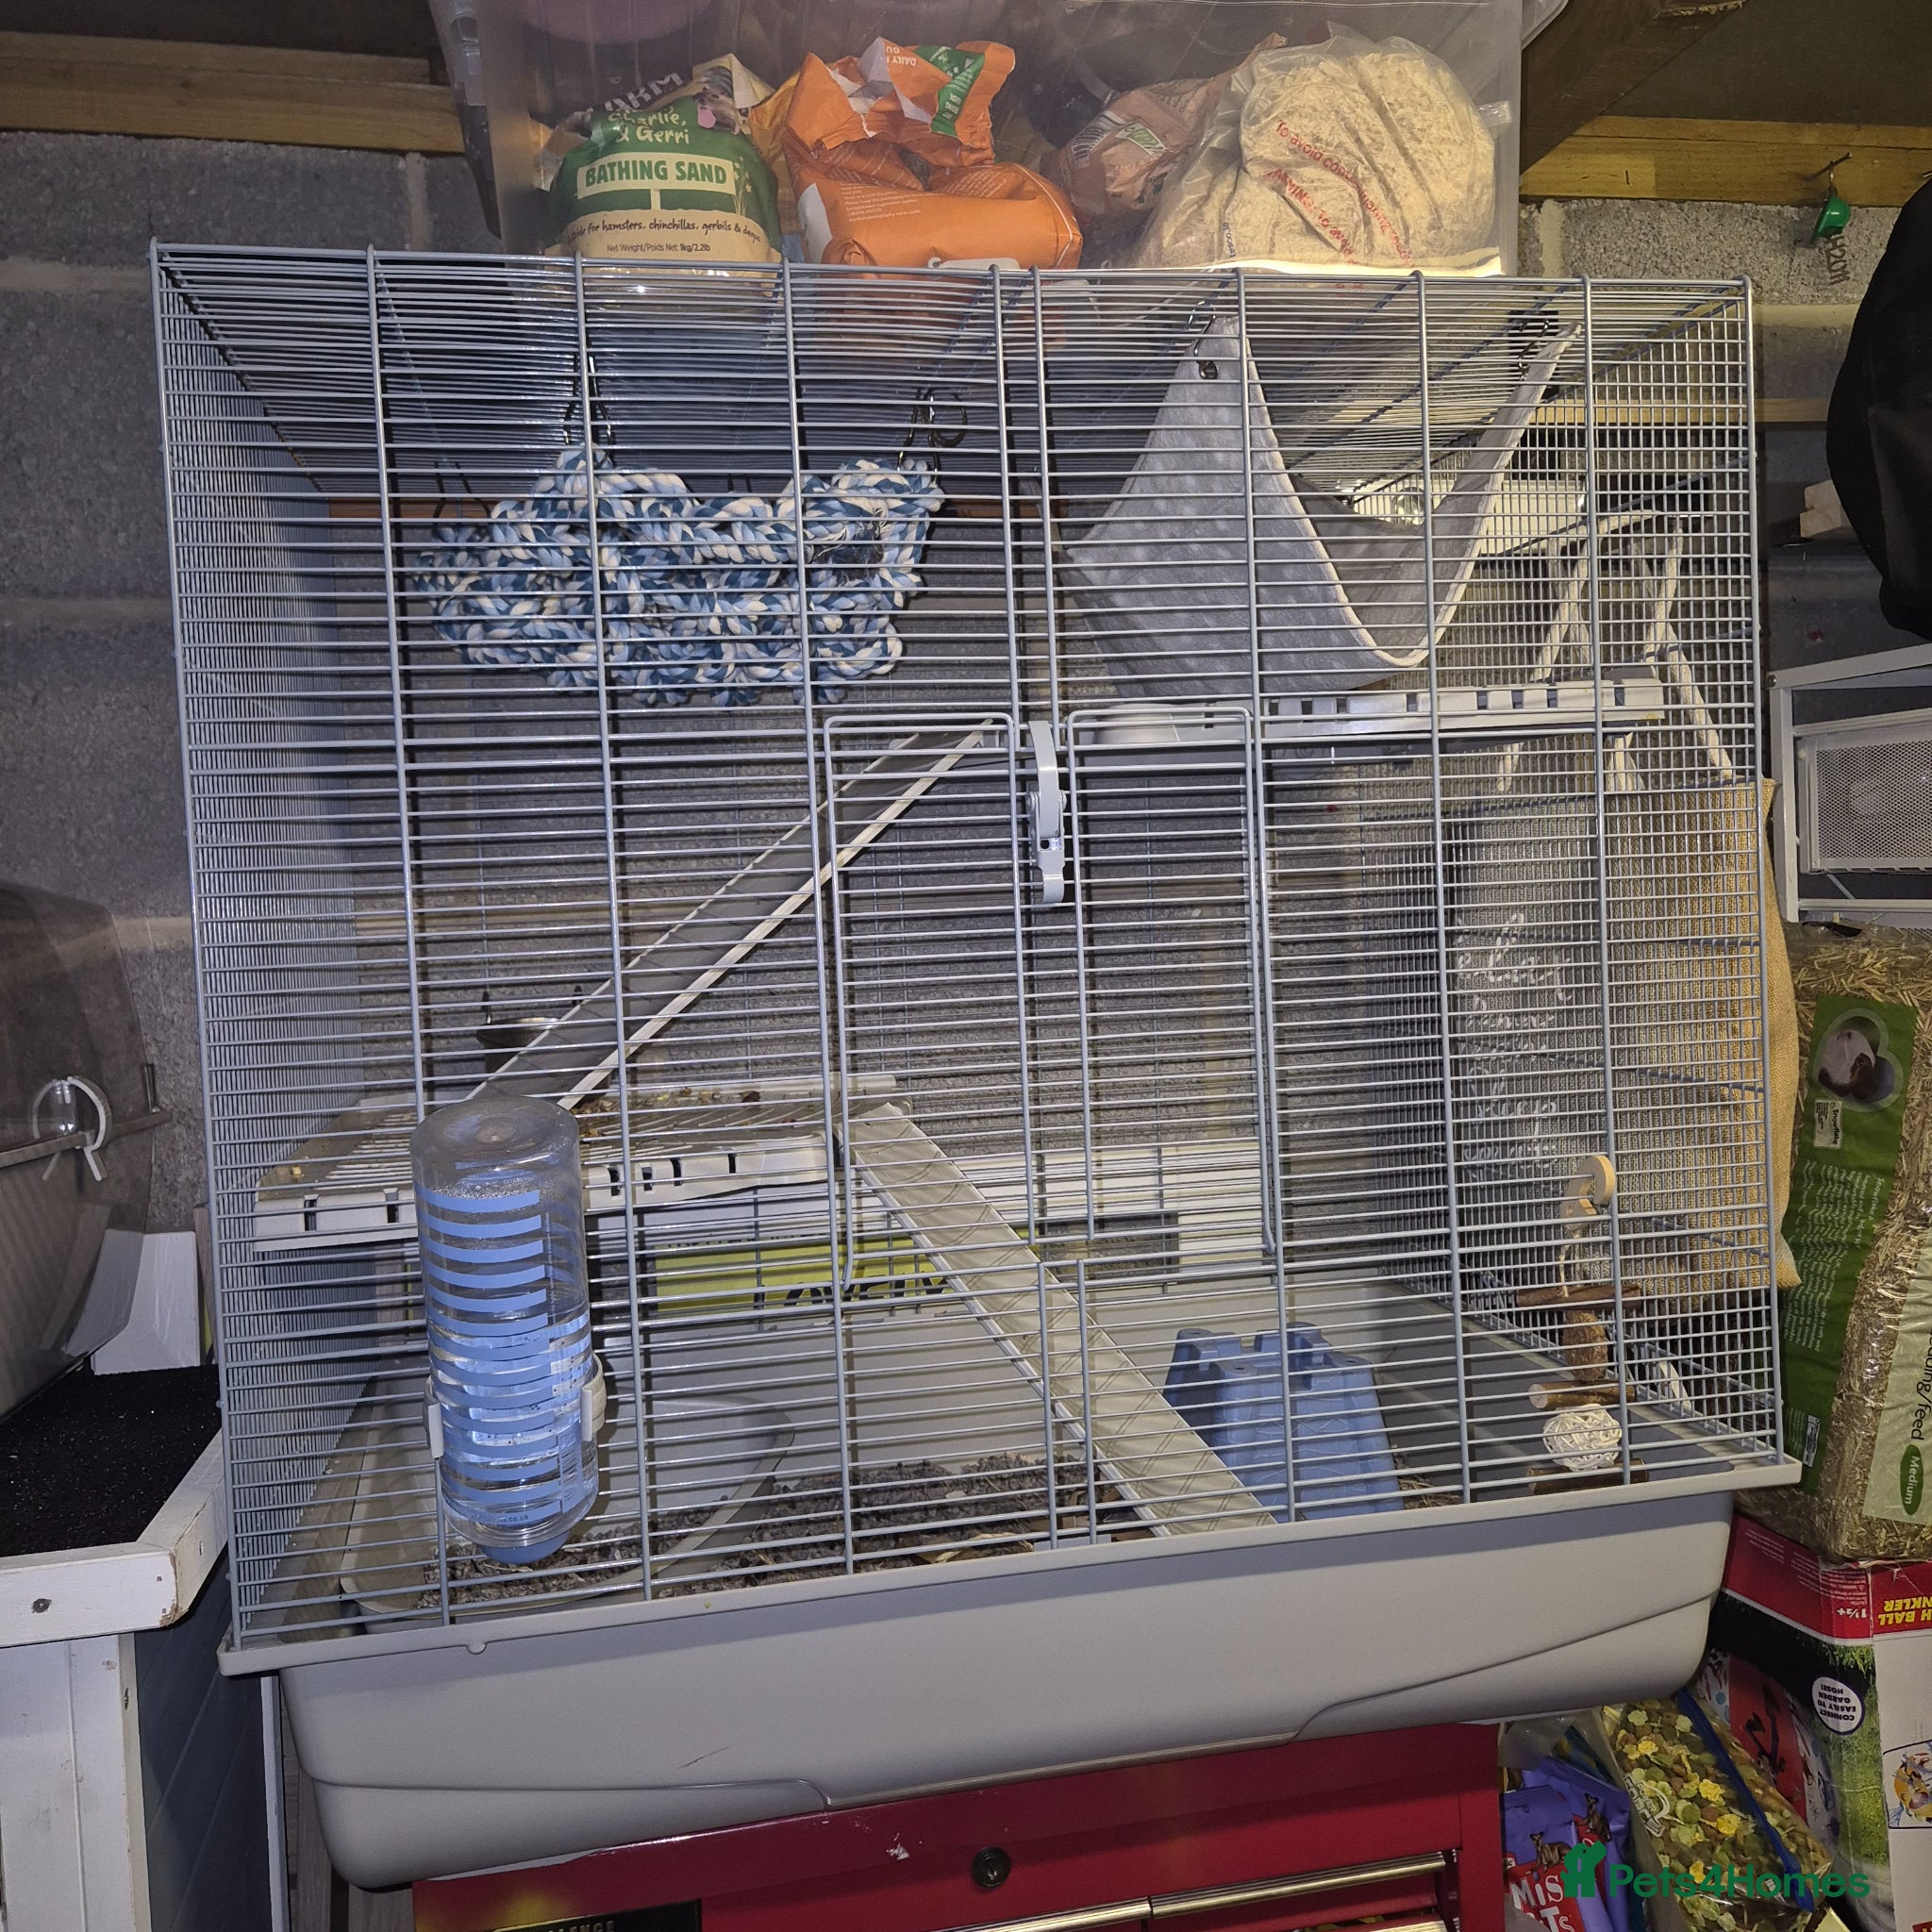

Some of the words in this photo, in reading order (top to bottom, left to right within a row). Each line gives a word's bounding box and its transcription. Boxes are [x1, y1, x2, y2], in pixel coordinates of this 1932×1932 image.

[891, 57, 917, 67] DAILY
[636, 126, 690, 144] Gerri
[585, 160, 668, 187] BATHING
[675, 161, 727, 184] SAND
[588, 220, 600, 234] for
[602, 219, 646, 232] hamsters,
[649, 218, 699, 231] chinchillas,
[702, 220, 732, 236] gerbils
[620, 243, 664, 253] Weight/Poids
[1869, 1176, 1885, 1216] Snowflake
[1905, 1456, 1921, 1505] Medium
[1877, 1610, 1916, 1625] BALL
[1820, 1683, 1844, 1695] HOSE!
[1817, 1699, 1826, 1707] TO
[1818, 1691, 1851, 1704] GARDEN
[1828, 1702, 1857, 1713] EASILY
[1820, 1708, 1855, 1721] CONNECT
